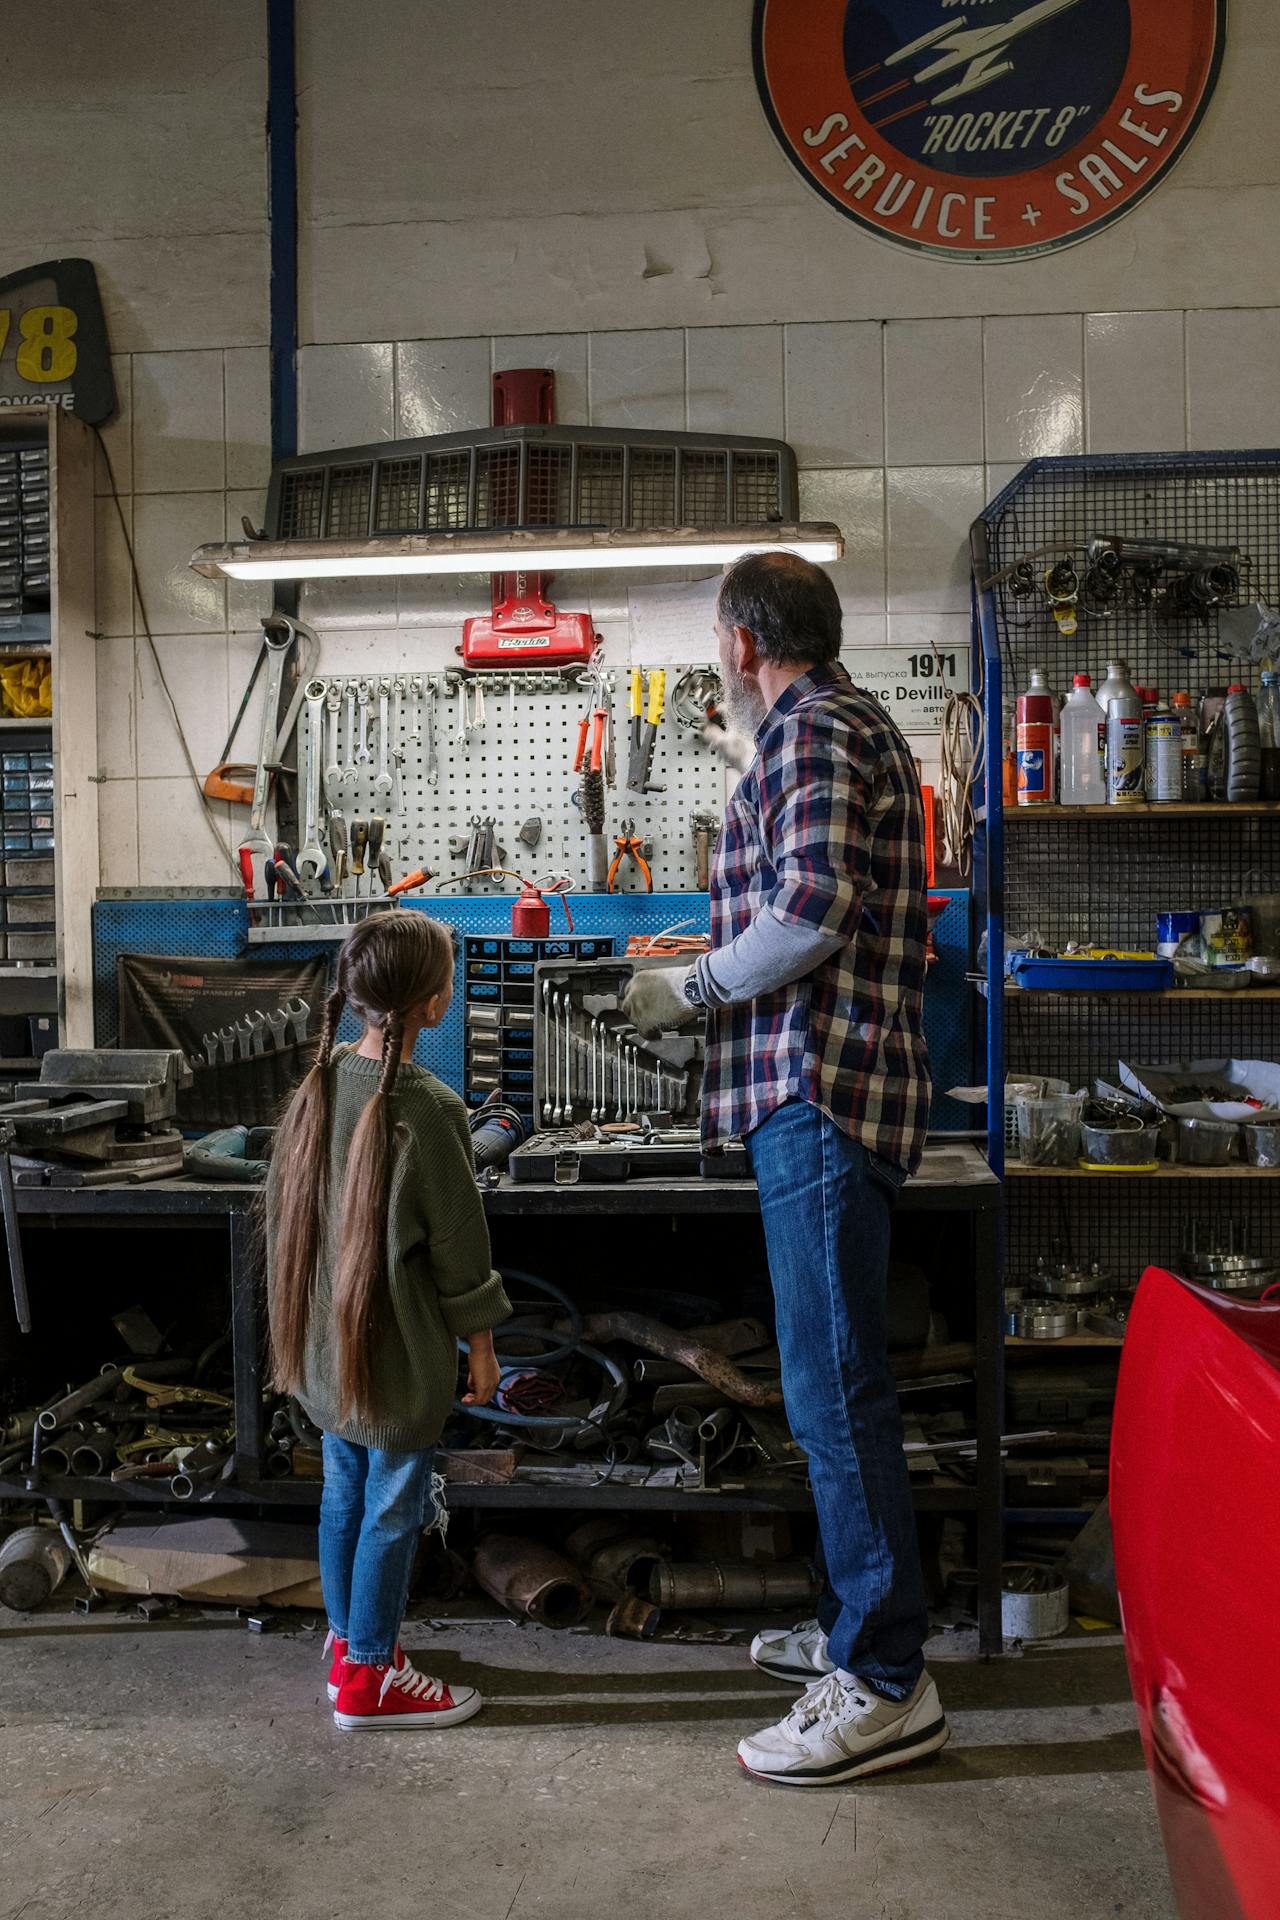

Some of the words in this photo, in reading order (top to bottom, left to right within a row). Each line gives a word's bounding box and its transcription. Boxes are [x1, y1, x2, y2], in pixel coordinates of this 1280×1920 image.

[921, 108, 1051, 154] "ROCKET
[1045, 105, 1091, 147] 8"
[1055, 83, 1183, 215] SALES
[866, 670, 907, 681] выпуска
[908, 654, 956, 677] 1971
[896, 686, 953, 700] Deville
[923, 705, 945, 713] авто
